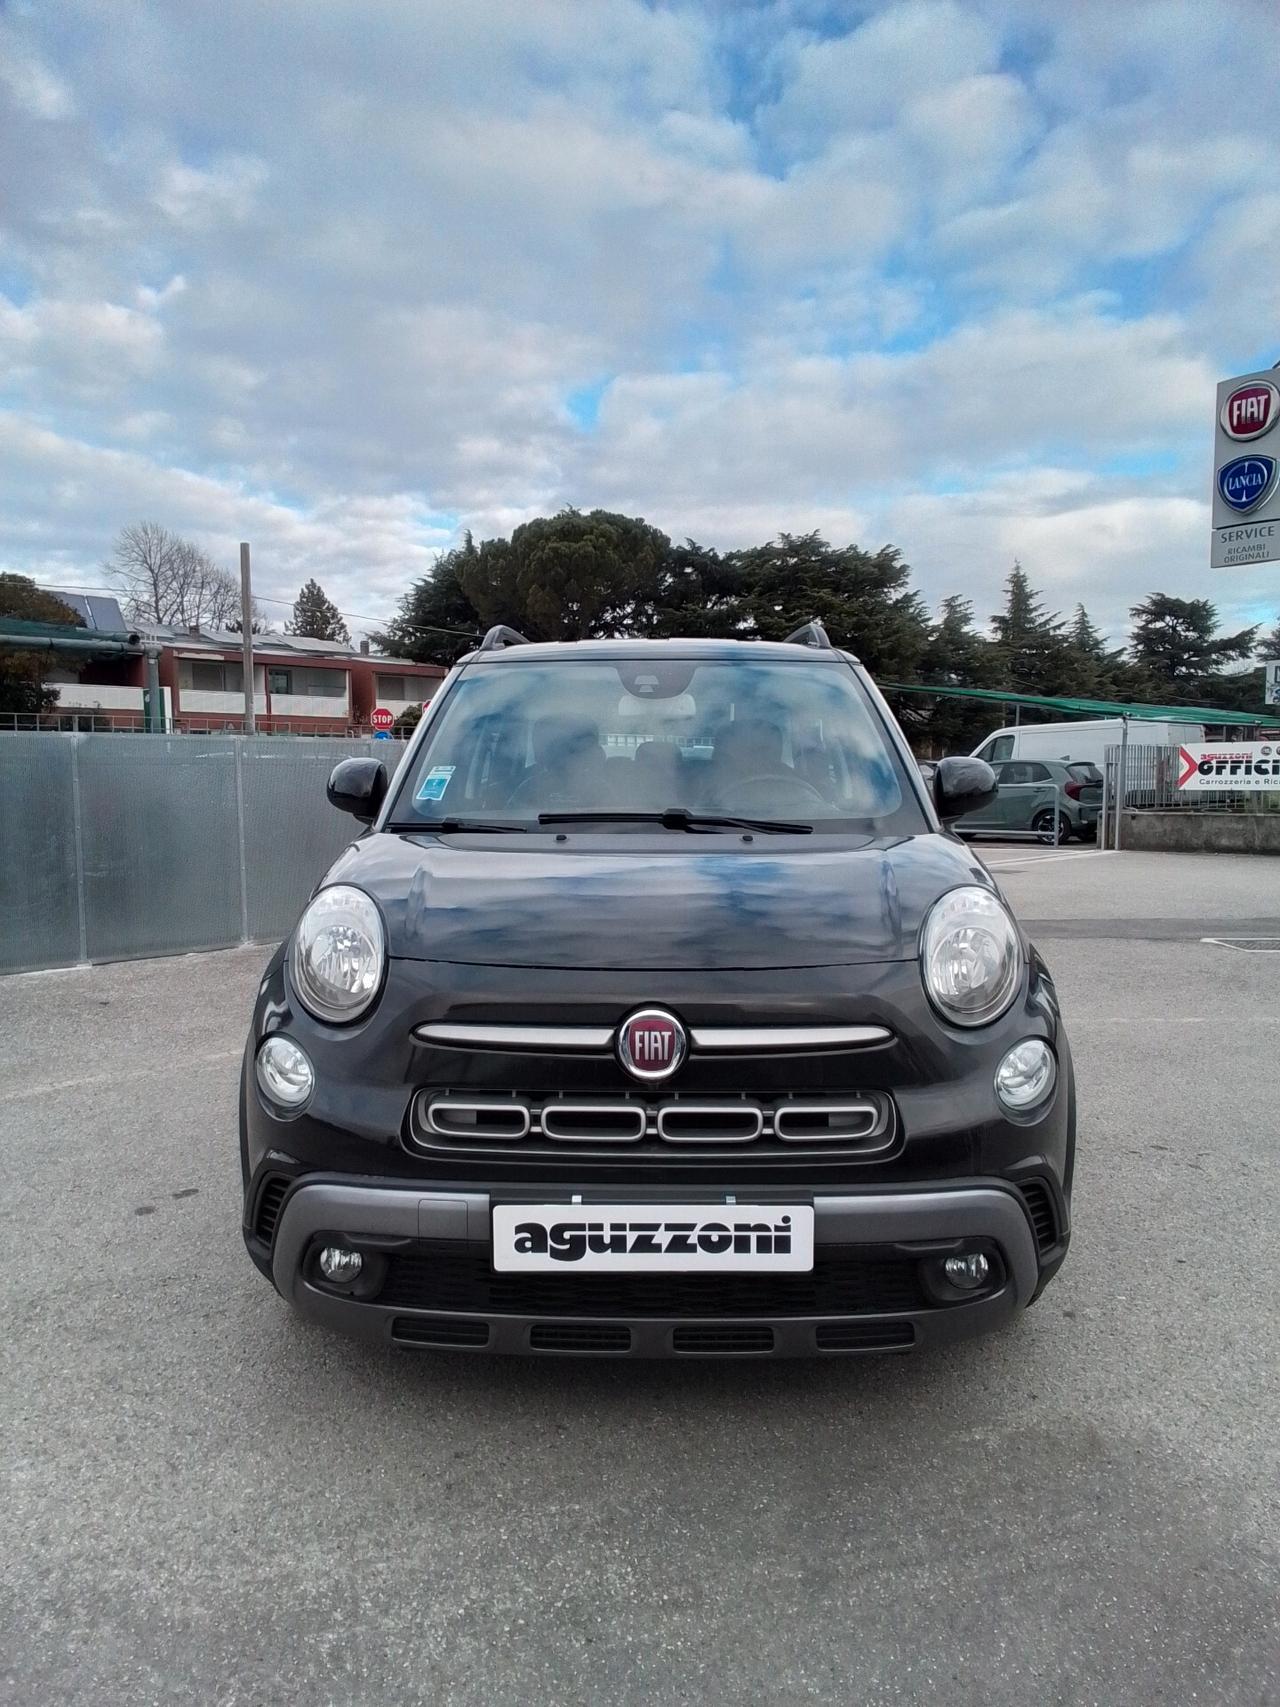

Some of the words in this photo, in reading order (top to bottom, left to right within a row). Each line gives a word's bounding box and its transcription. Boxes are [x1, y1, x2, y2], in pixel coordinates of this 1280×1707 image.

[1232, 394, 1269, 427] FIAT
[1228, 472, 1262, 491] LANCIA
[1220, 525, 1275, 544] SERVICE
[1223, 551, 1270, 564] ORIGINALI
[1227, 543, 1266, 555] RICAMBI
[373, 714, 392, 724] STOP
[634, 1031, 672, 1061] FIAT
[513, 1214, 793, 1263] aguzzoni
